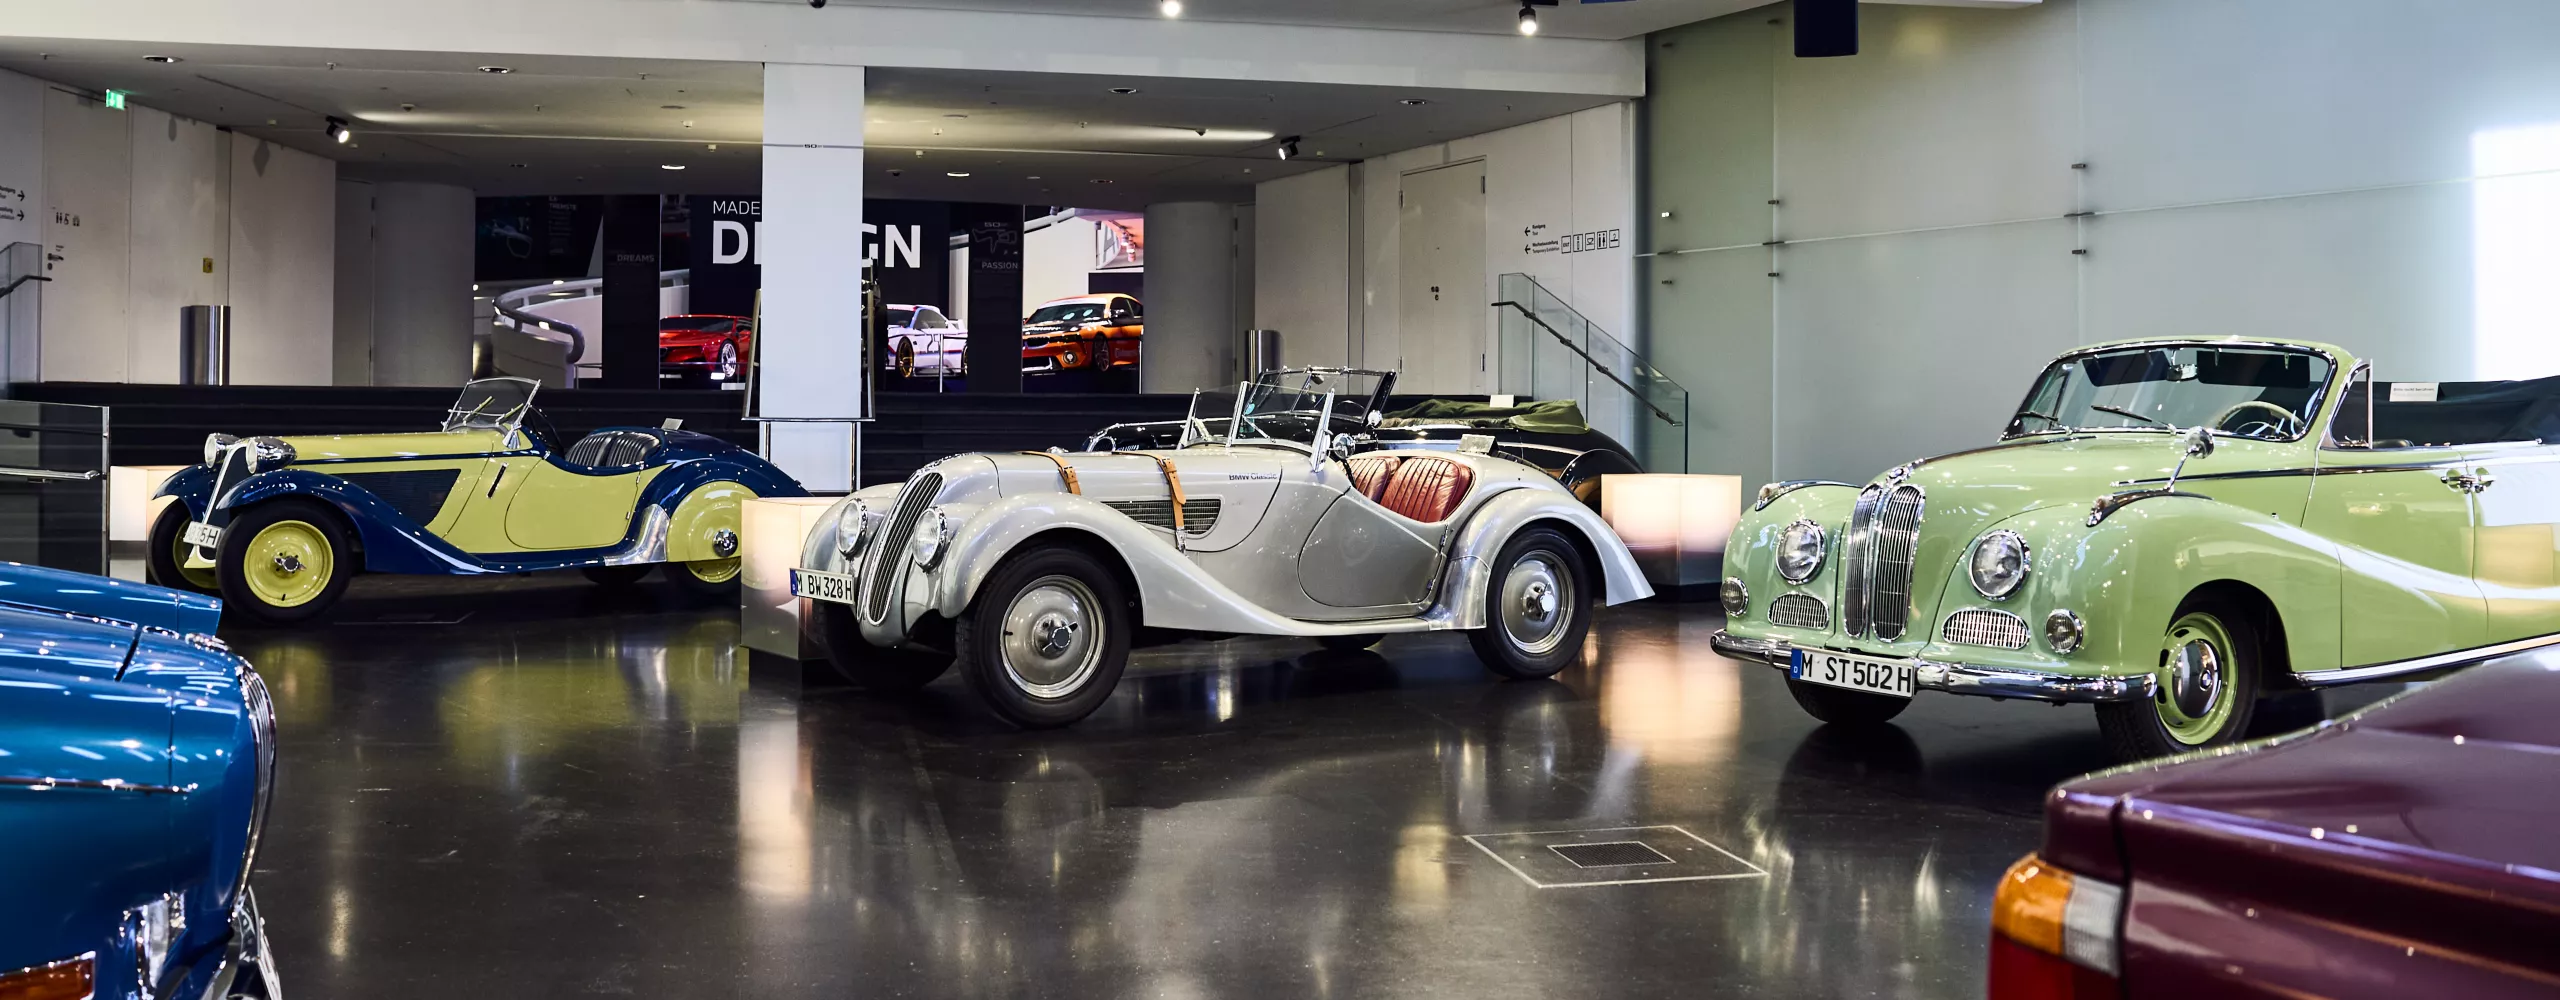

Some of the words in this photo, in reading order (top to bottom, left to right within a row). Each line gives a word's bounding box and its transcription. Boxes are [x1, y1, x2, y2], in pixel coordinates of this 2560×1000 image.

[712, 200, 761, 215] MADE
[617, 254, 655, 262] DREAMS
[981, 261, 1018, 269] PASSION
[1229, 473, 1250, 481] BMW
[795, 572, 803, 593] M
[1801, 652, 1813, 678] M
